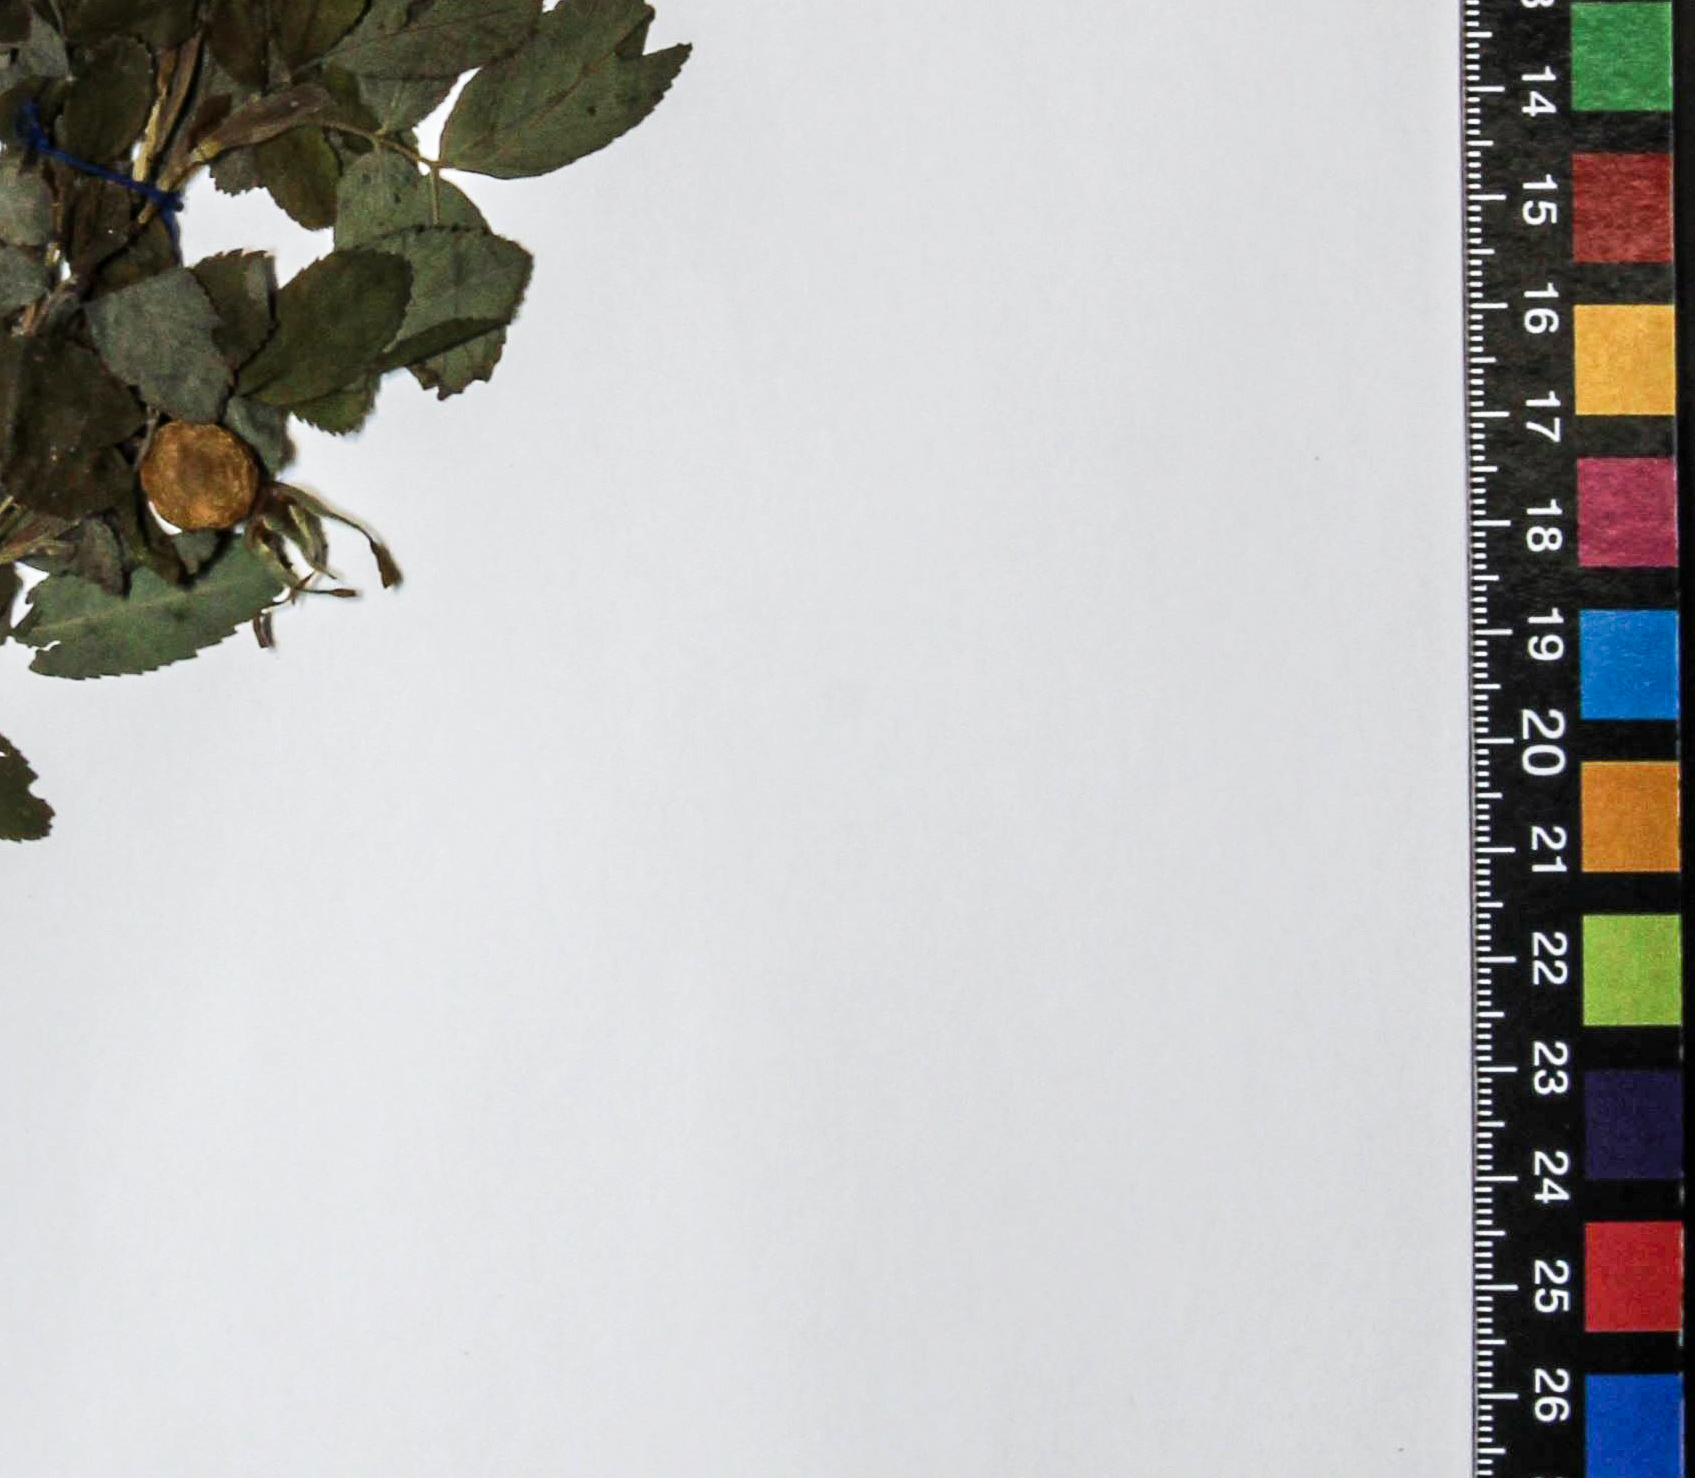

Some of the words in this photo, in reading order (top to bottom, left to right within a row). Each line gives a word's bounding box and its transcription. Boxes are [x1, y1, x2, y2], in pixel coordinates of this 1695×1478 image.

[1521, 65, 1557, 117] 14
[1522, 173, 1558, 226] 15
[1523, 282, 1560, 334] 16
[1525, 390, 1562, 443] 17
[1525, 498, 1563, 553] 18
[1527, 607, 1565, 661] 19
[1522, 708, 1566, 776] 20
[1531, 825, 1568, 873] 21
[1532, 931, 1568, 985] 22
[1533, 1041, 1569, 1096] 23
[1534, 1150, 1570, 1204] 24
[1534, 1259, 1570, 1313] 25
[1534, 1368, 1570, 1422] 26
